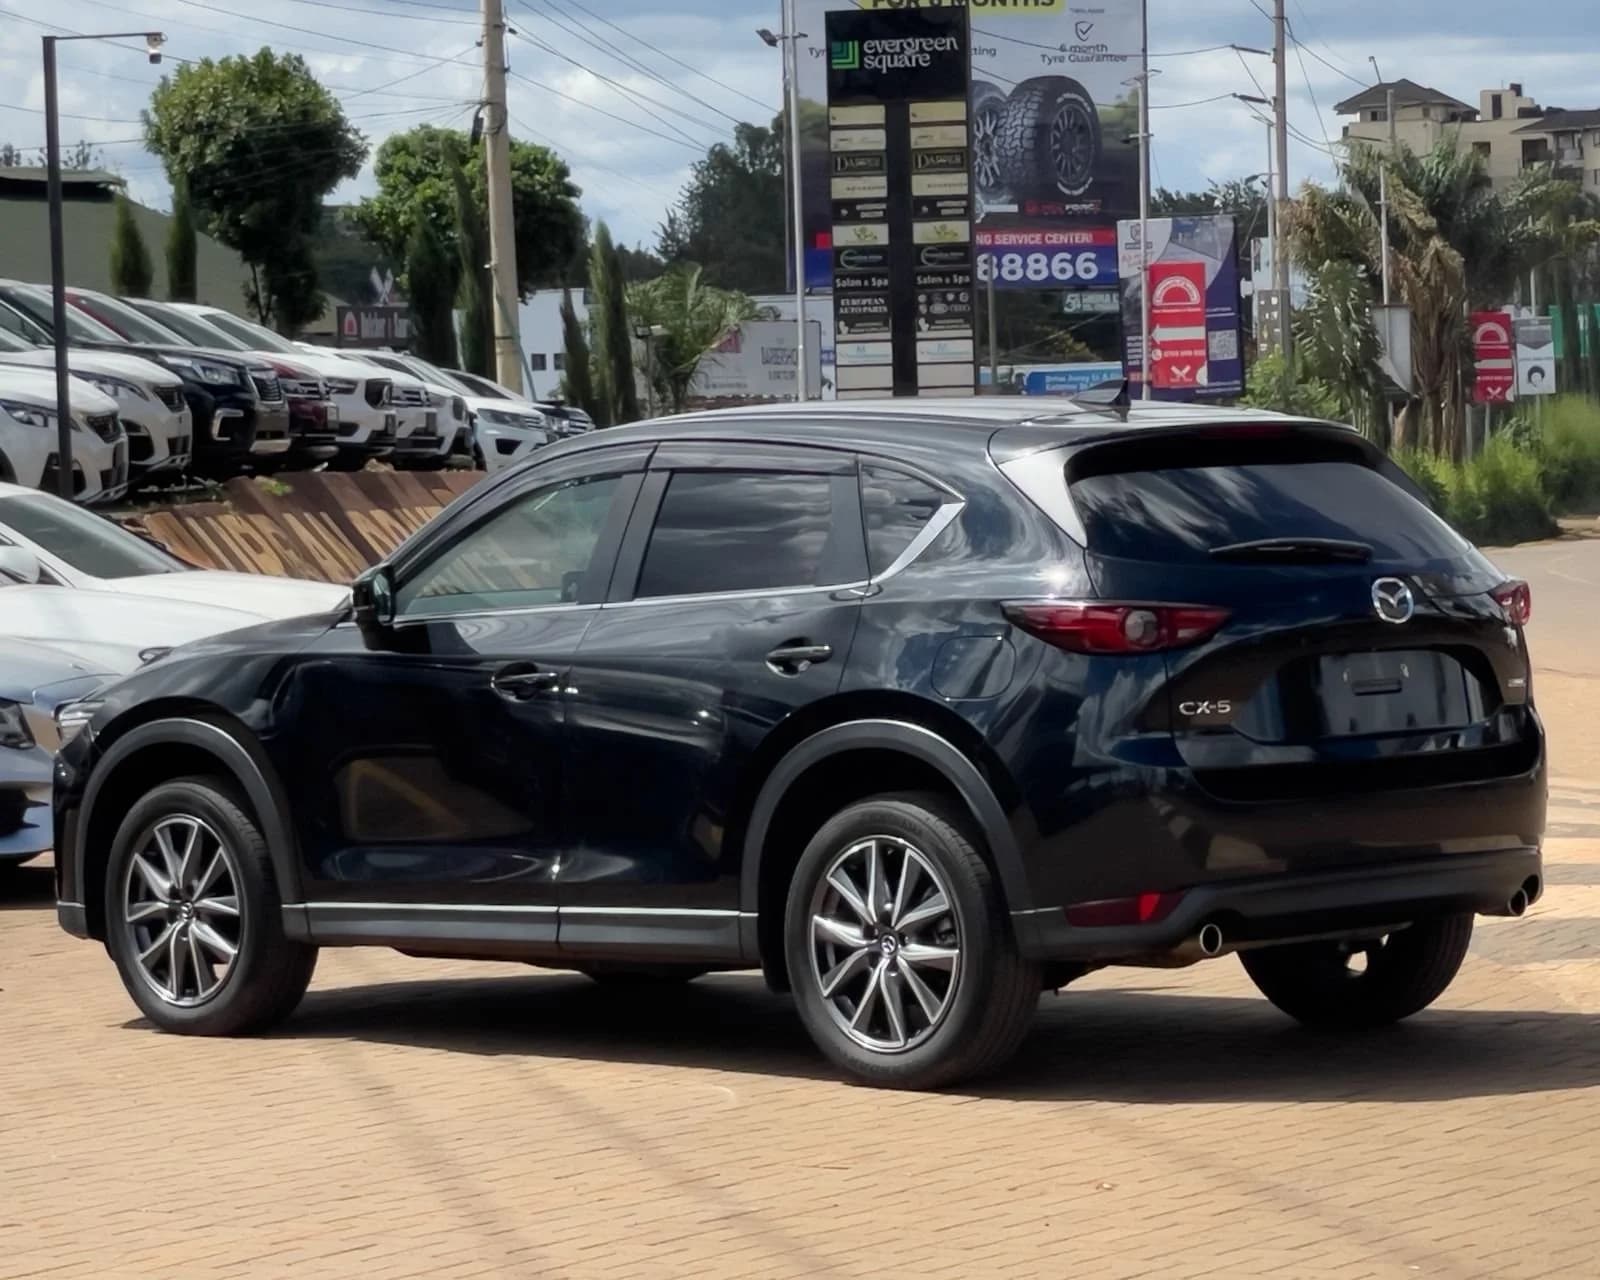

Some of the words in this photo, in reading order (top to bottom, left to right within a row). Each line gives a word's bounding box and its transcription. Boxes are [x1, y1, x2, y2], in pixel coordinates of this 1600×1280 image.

[863, 36, 959, 56] evergreen
[1070, 44, 1108, 53] month
[864, 52, 931, 74] square
[1040, 54, 1066, 65] Tyre
[1068, 53, 1128, 63] Guarantee
[995, 233, 1042, 245] SERVICE
[1045, 231, 1094, 244] CENTER!
[977, 252, 1098, 280] 88866
[1179, 699, 1231, 716] CX-5
